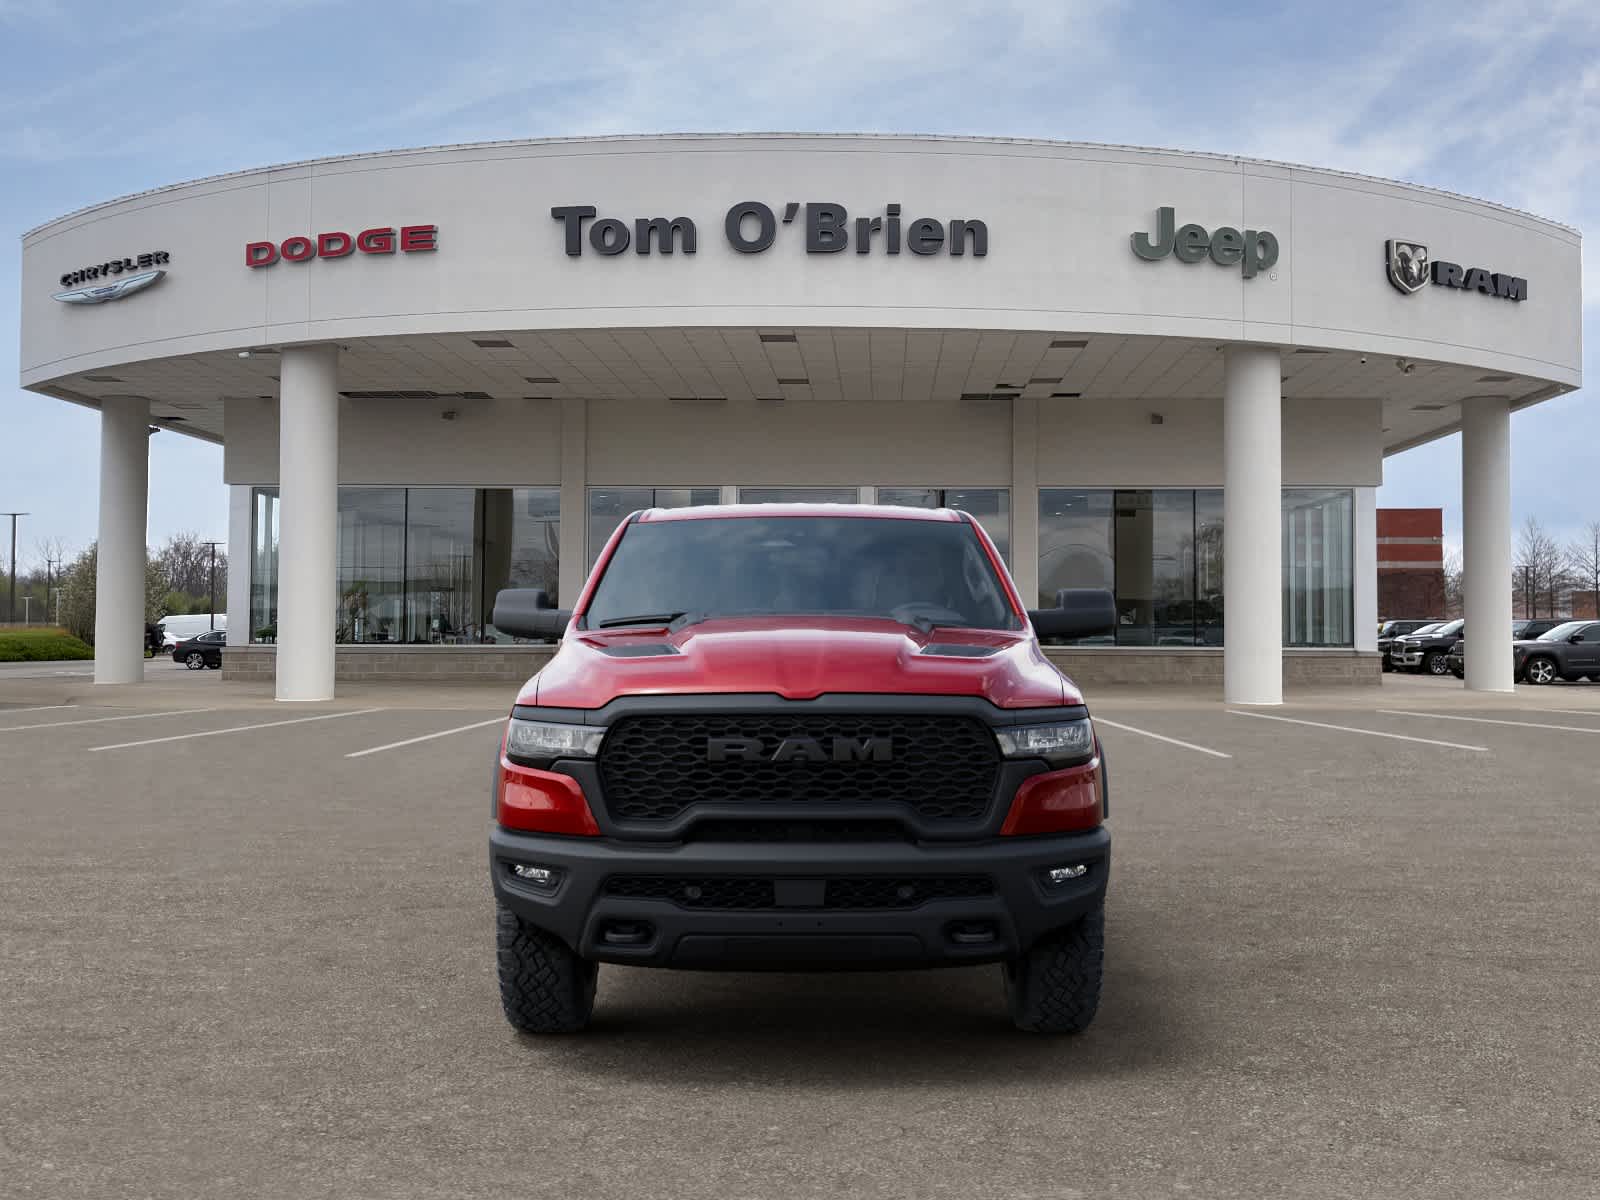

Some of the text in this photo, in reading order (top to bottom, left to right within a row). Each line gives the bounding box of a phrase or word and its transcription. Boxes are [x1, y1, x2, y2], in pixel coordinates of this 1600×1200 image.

[246, 224, 438, 269] DODGE
[551, 205, 696, 257] Tom
[1130, 206, 1279, 279] Jeep
[60, 251, 170, 287] CHRYSLER
[1431, 260, 1528, 301] RAM
[707, 736, 892, 761] RAM
